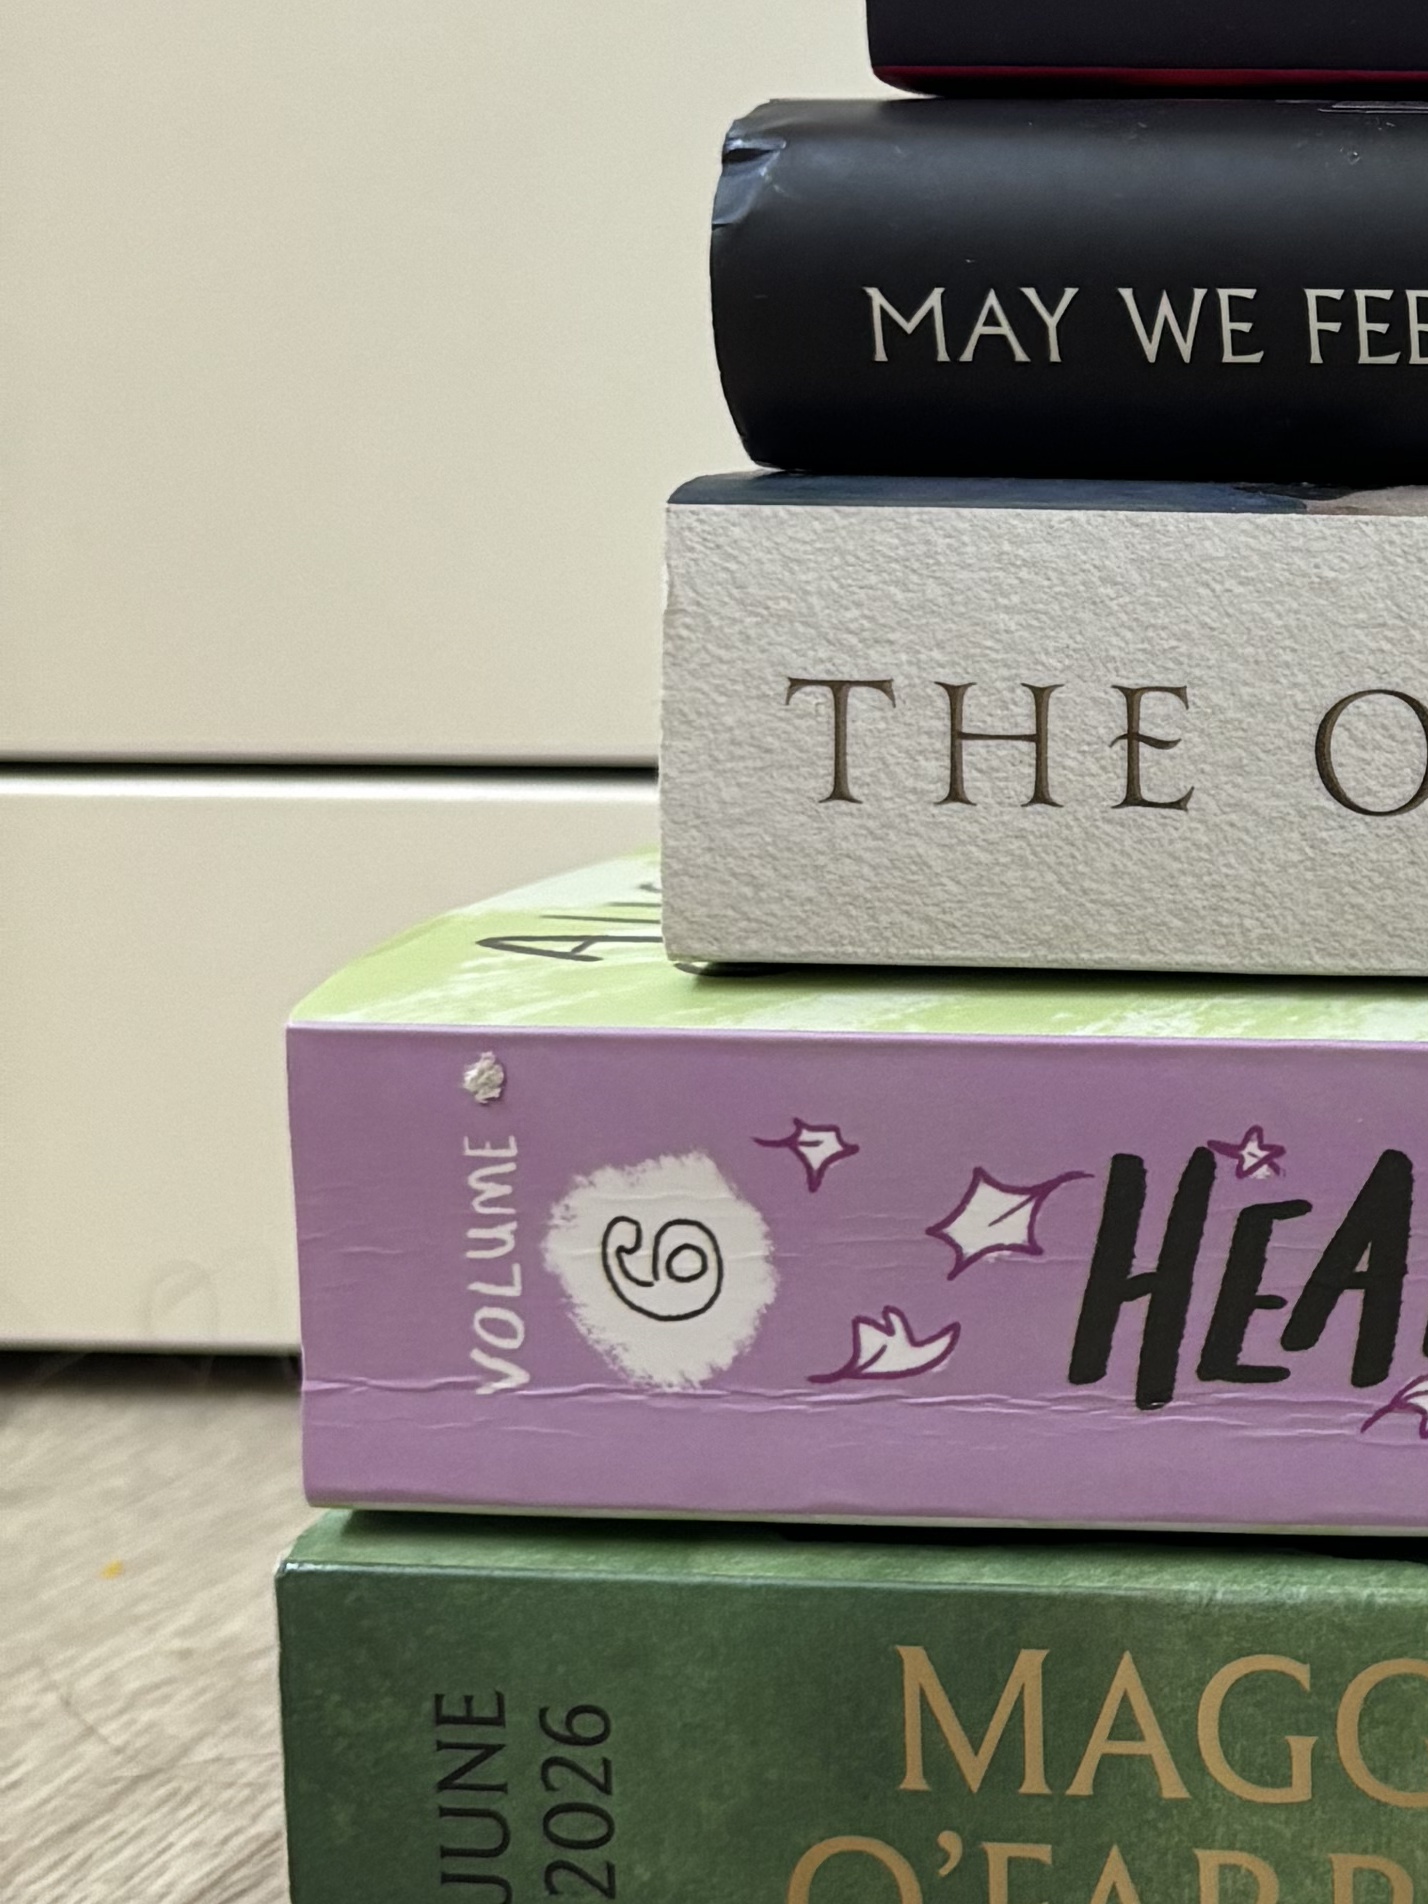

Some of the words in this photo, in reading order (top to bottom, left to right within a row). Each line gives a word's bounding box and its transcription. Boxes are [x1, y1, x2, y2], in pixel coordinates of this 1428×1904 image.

[864, 286, 1079, 363] MAY
[1117, 287, 1264, 364] WE
[785, 676, 1195, 813] THE
[463, 1136, 531, 1396] VOLUME
[600, 1214, 725, 1324] 6
[537, 1700, 617, 1901] 2026
